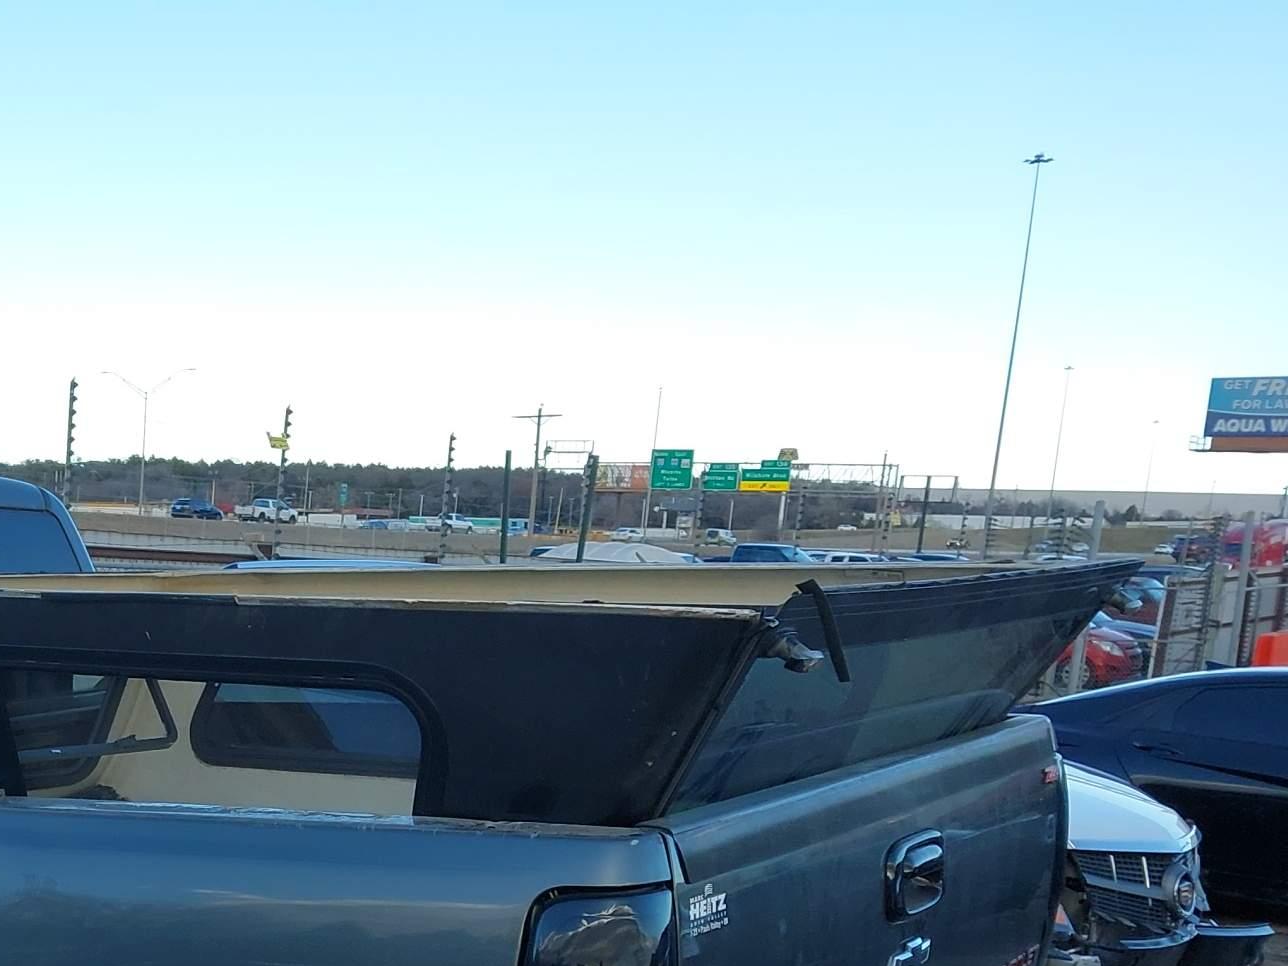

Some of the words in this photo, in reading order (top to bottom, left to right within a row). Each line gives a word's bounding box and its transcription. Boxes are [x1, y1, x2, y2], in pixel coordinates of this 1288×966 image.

[1223, 379, 1252, 390] GET
[1232, 399, 1261, 410] FOR
[1264, 399, 1288, 410] LA
[1212, 418, 1266, 433] AQUA
[689, 892, 727, 921] HEITZ
